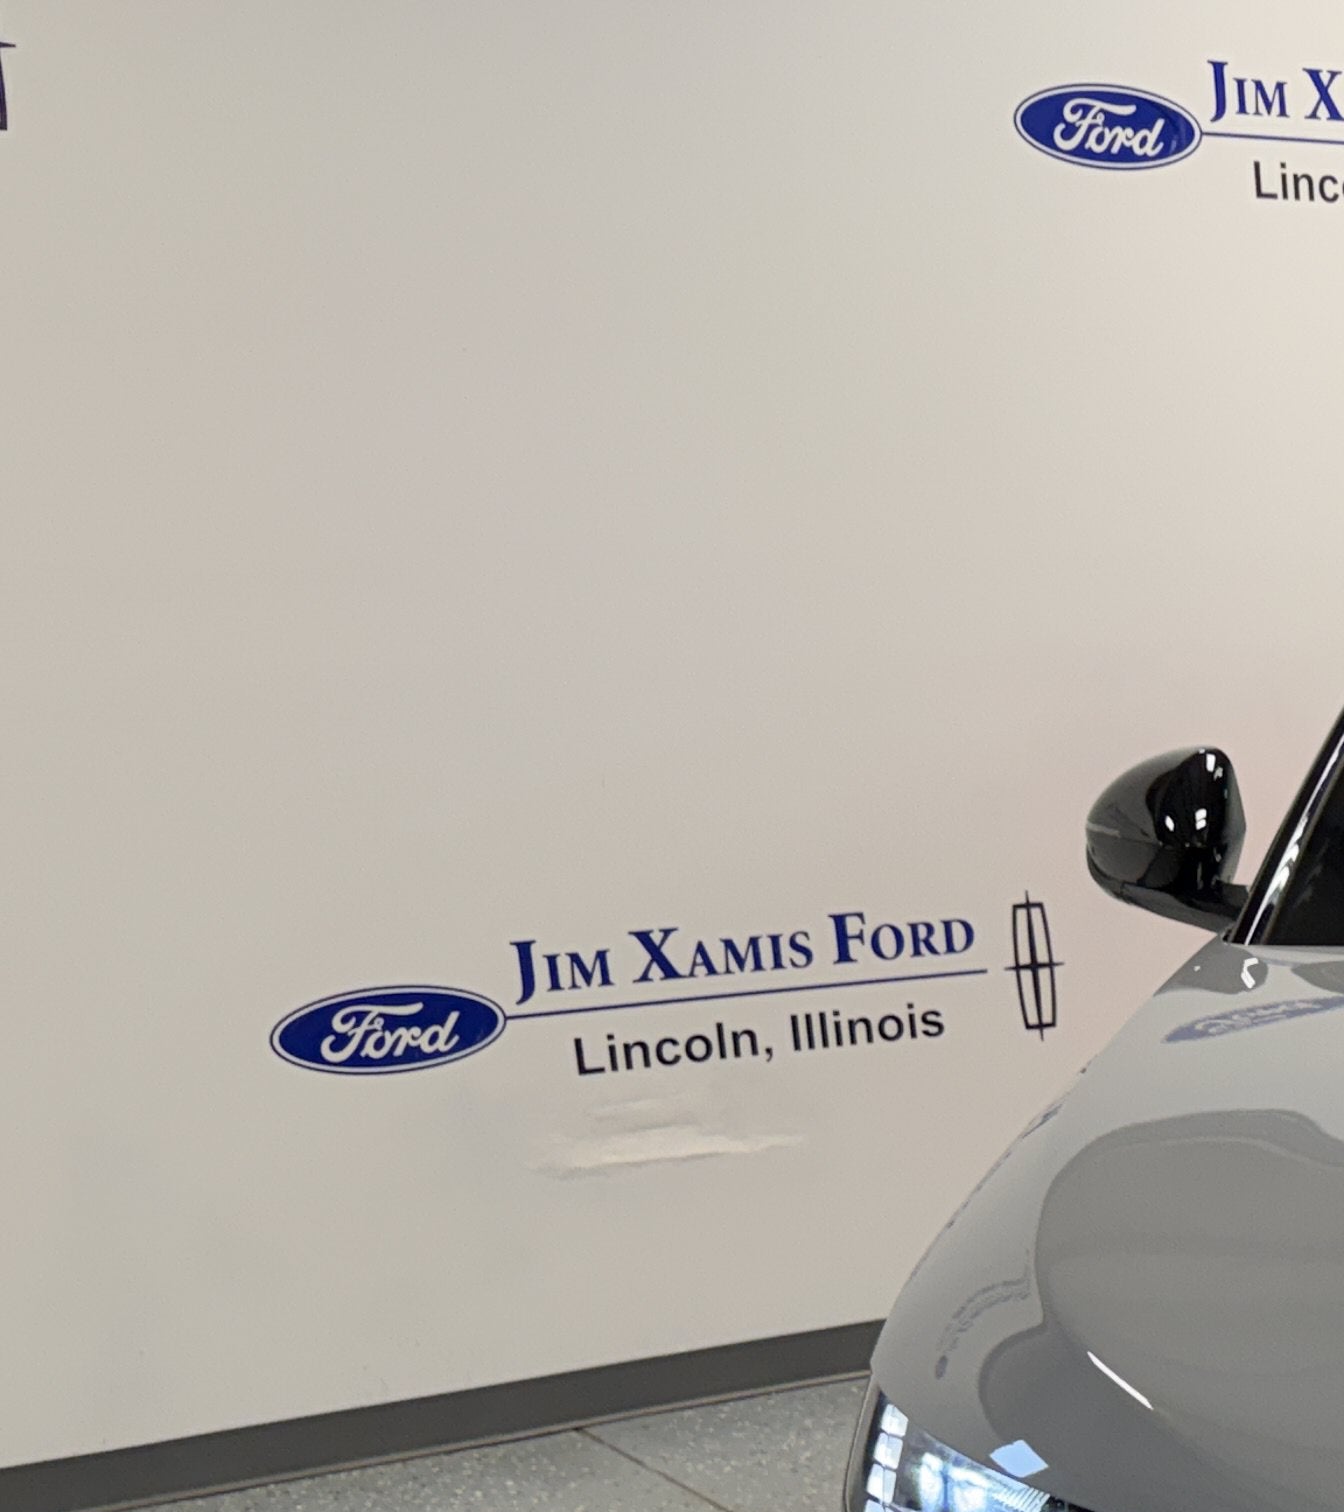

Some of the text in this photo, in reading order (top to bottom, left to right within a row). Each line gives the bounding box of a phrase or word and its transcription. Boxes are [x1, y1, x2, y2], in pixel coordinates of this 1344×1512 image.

[1207, 60, 1288, 123] JIM
[1053, 98, 1164, 157] Ford
[510, 912, 975, 1005] JIM XAMIS FORD
[321, 1003, 458, 1063] Ford
[573, 1003, 945, 1076] Lincoln, Illinois
